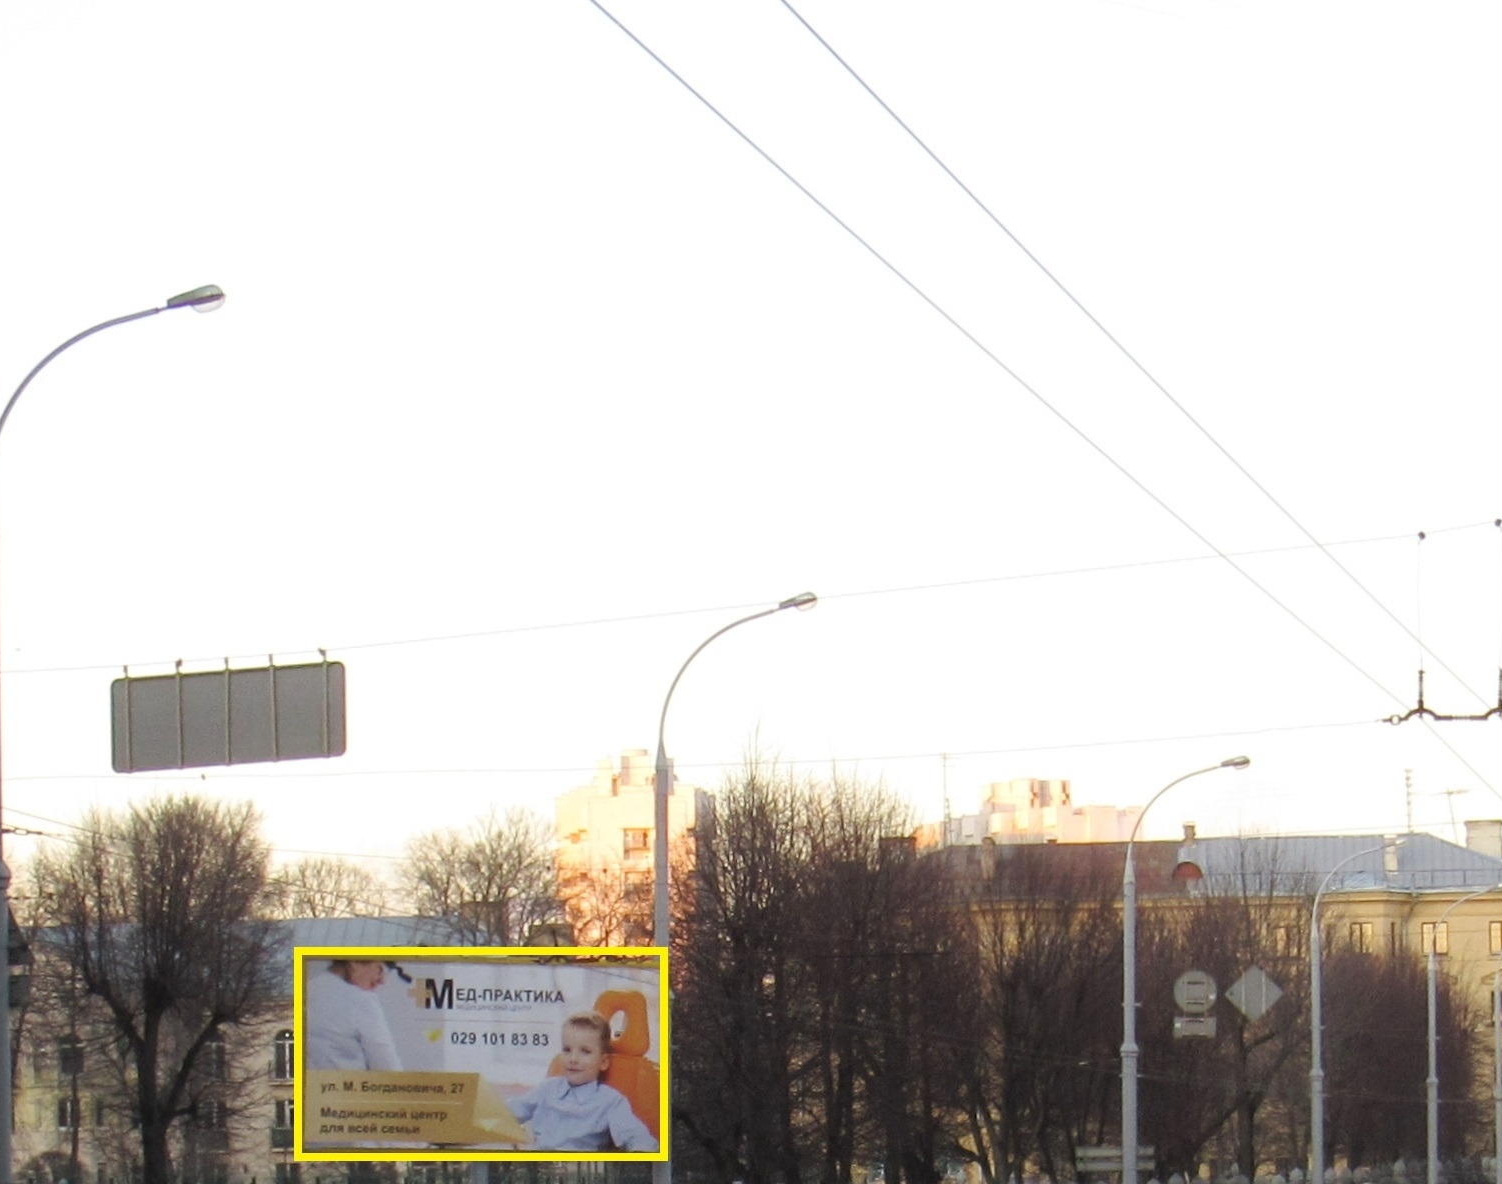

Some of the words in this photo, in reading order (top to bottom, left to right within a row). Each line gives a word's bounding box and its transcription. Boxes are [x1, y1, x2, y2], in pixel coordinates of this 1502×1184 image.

[451, 1032, 476, 1045] 029
[482, 1033, 505, 1045] 101
[511, 1033, 528, 1046] 83
[532, 1034, 550, 1047] 83
[451, 1083, 465, 1094] 27
[320, 1107, 408, 1120] Медицинский
[411, 1110, 448, 1122] центр
[319, 1124, 344, 1134] для
[348, 1123, 378, 1134] всей
[381, 1124, 421, 1134] семьи
